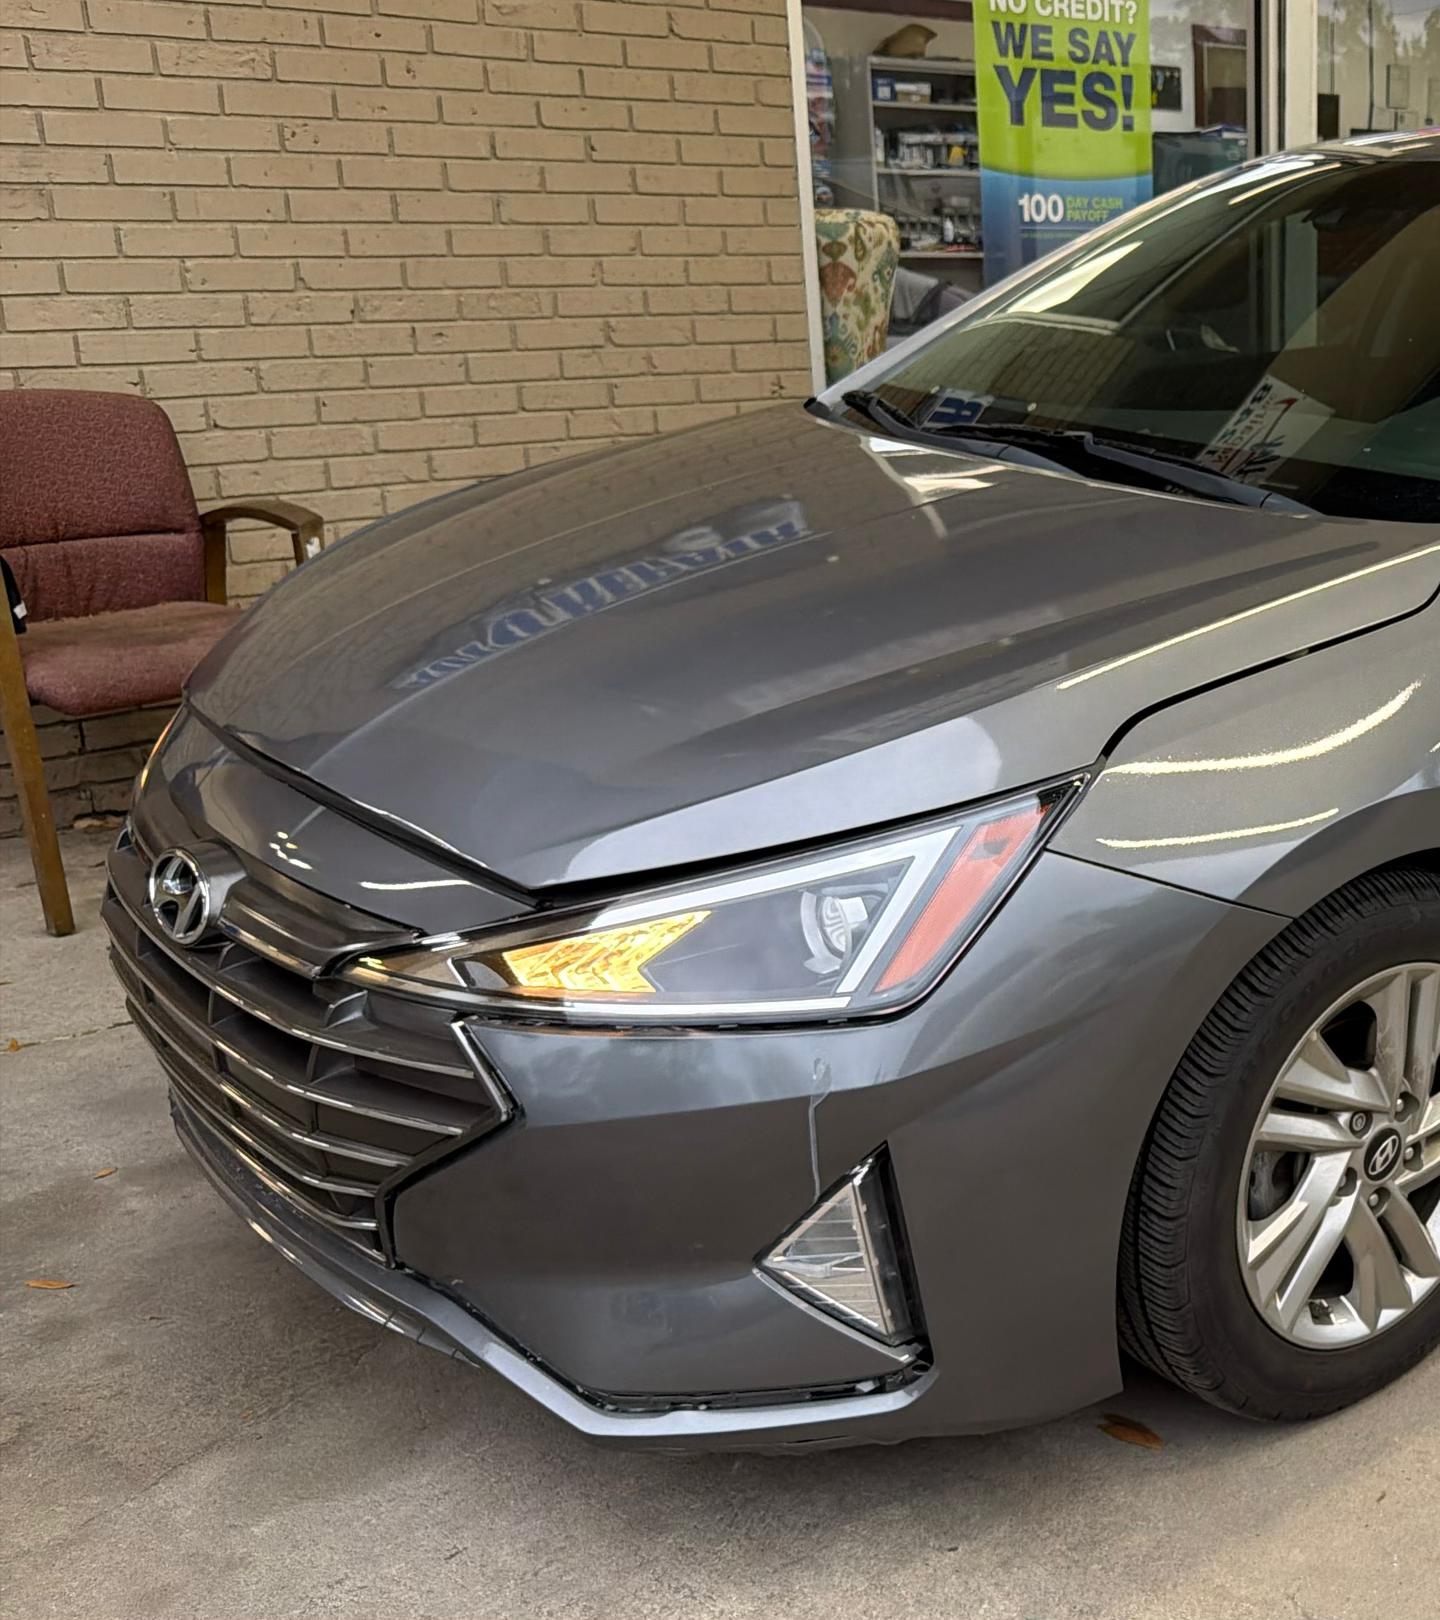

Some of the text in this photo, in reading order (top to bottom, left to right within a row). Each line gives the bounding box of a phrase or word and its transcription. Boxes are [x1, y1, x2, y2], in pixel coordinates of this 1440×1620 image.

[1035, 0, 1138, 24] CREDIT?
[991, 20, 1137, 67] WE SAY
[993, 65, 1135, 132] YES!
[1018, 193, 1124, 223] 100 DAY CASH
[1066, 209, 1110, 222] PAYOFF
